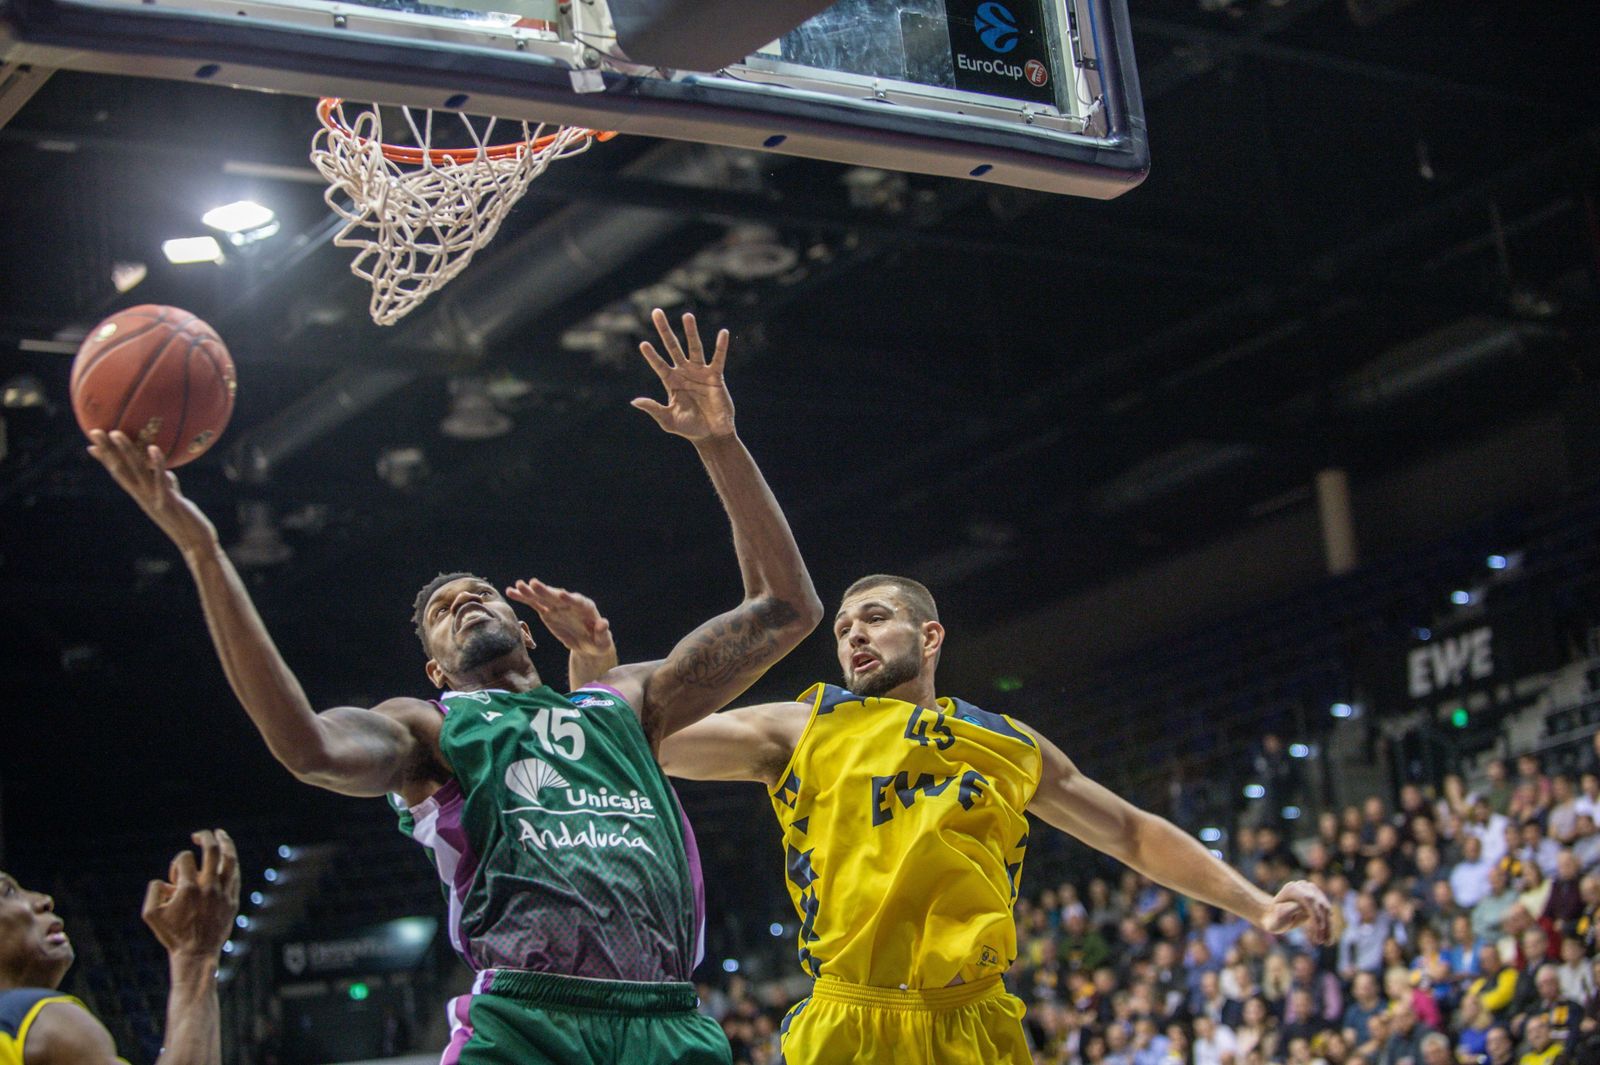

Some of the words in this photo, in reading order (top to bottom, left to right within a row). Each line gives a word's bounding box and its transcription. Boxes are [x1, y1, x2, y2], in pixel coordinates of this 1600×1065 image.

[957, 54, 1023, 80] EuroCup
[1408, 626, 1493, 697] EWE
[530, 707, 586, 761] 15
[904, 705, 955, 750] 45
[566, 787, 653, 814] Unicaja
[518, 818, 656, 856] Andalucía
